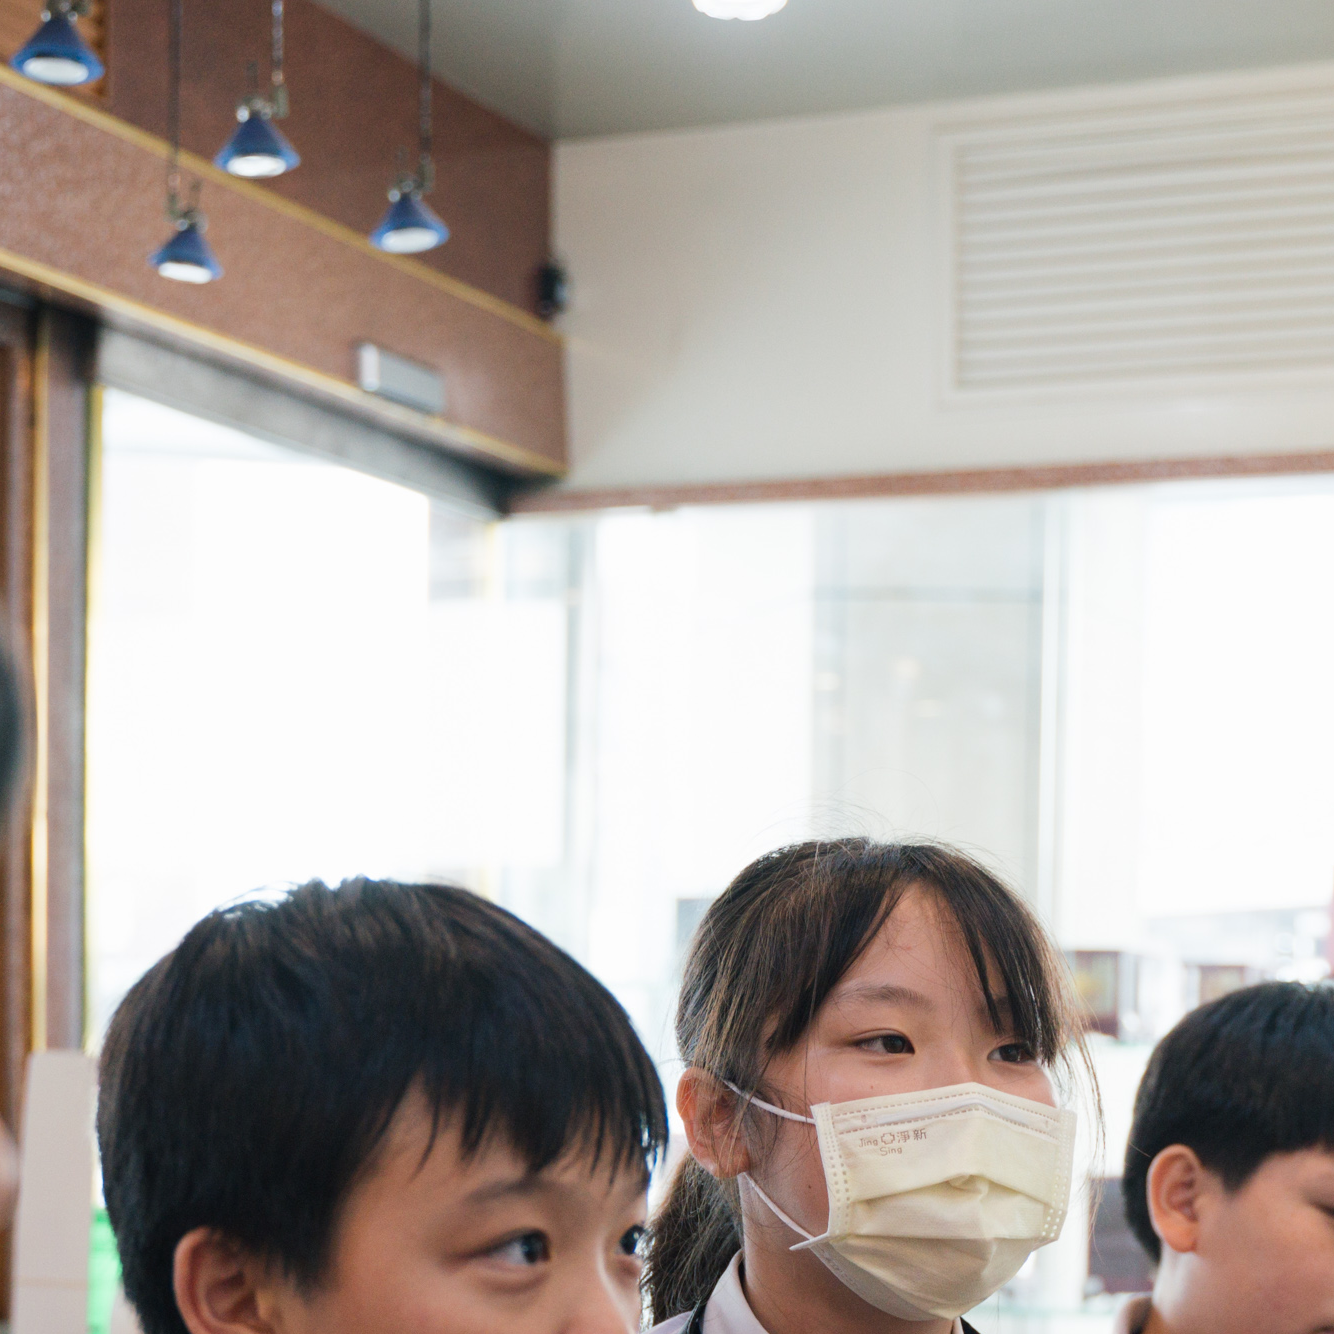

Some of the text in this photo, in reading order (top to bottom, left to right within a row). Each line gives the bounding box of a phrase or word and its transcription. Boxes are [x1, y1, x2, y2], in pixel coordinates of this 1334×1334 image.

[896, 1127, 927, 1143] 淨新
[858, 1137, 878, 1147] Jing
[879, 1146, 903, 1156] Sing
